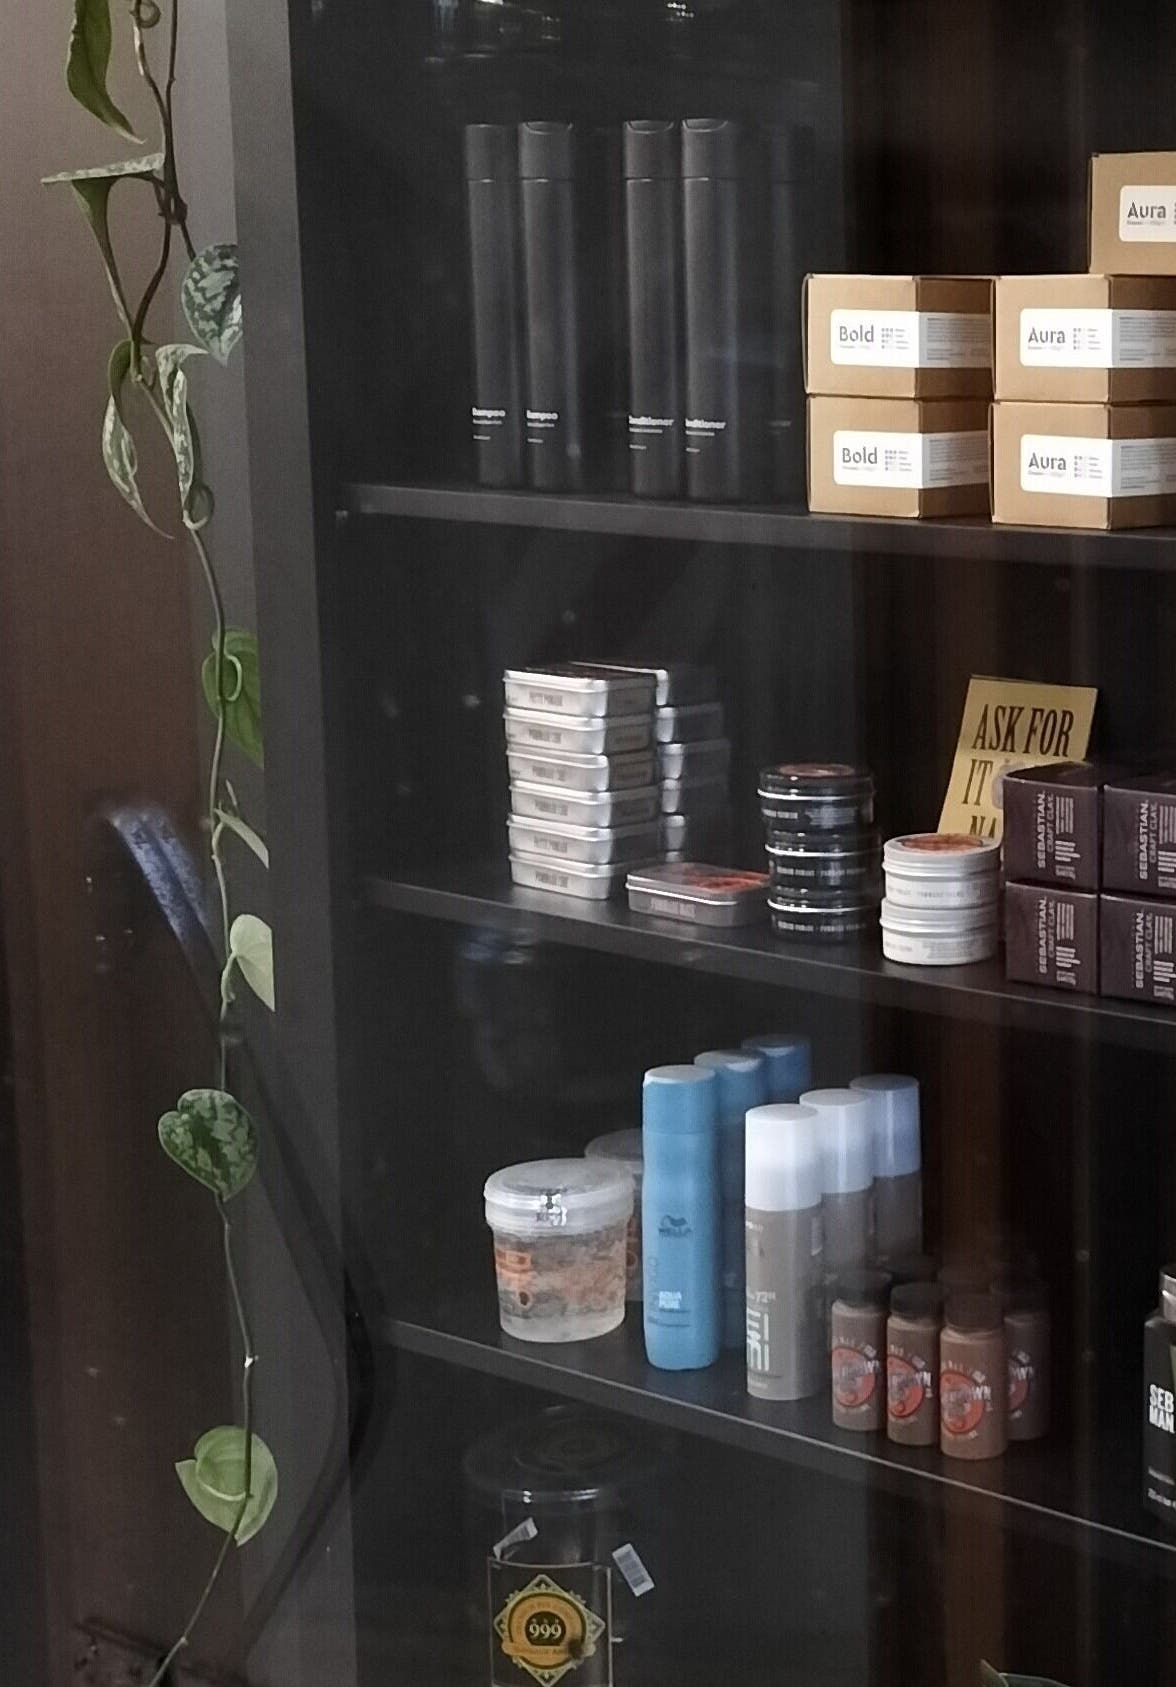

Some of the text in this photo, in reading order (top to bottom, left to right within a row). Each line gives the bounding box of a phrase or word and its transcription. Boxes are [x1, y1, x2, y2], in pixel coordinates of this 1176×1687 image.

[1126, 201, 1168, 221] Aura
[838, 324, 875, 343] Bold
[1027, 326, 1066, 345] Aura
[842, 446, 878, 465] Bold
[1028, 451, 1067, 471] Aura
[971, 703, 1075, 758] ASK FOR
[961, 758, 994, 806] IT
[1149, 1383, 1175, 1413] SEB
[529, 1623, 562, 1639] 999
